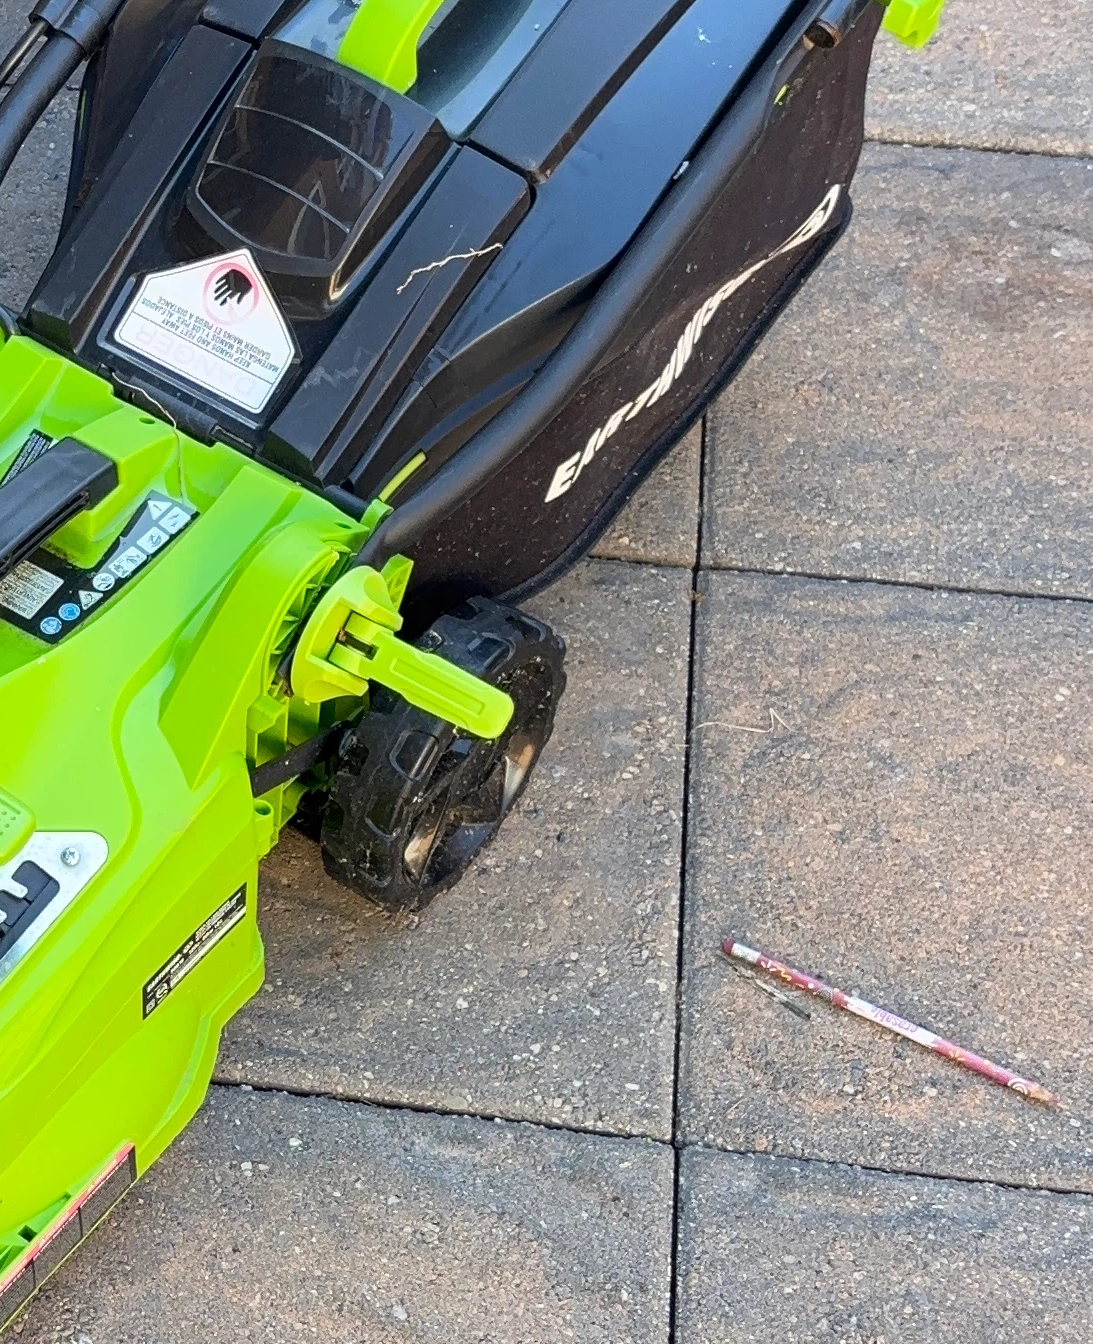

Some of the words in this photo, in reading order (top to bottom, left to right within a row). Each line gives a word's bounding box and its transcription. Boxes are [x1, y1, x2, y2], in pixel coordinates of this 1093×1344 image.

[139, 296, 175, 319] ALEJADOS
[155, 295, 189, 318] DISTANCE
[160, 316, 180, 332] AWAY
[174, 314, 191, 328] PIES
[193, 315, 214, 331] PIEDS
[179, 326, 197, 340] FEET
[190, 322, 206, 336] LOS
[204, 330, 211, 338] Y
[212, 325, 222, 335] ET
[195, 334, 211, 348] AND
[209, 333, 235, 351] MANOS
[221, 329, 244, 346] MAINS
[210, 342, 234, 360] HANDS
[233, 345, 249, 358] LAS
[242, 341, 271, 360] GARDER
[232, 354, 251, 368] KEEP
